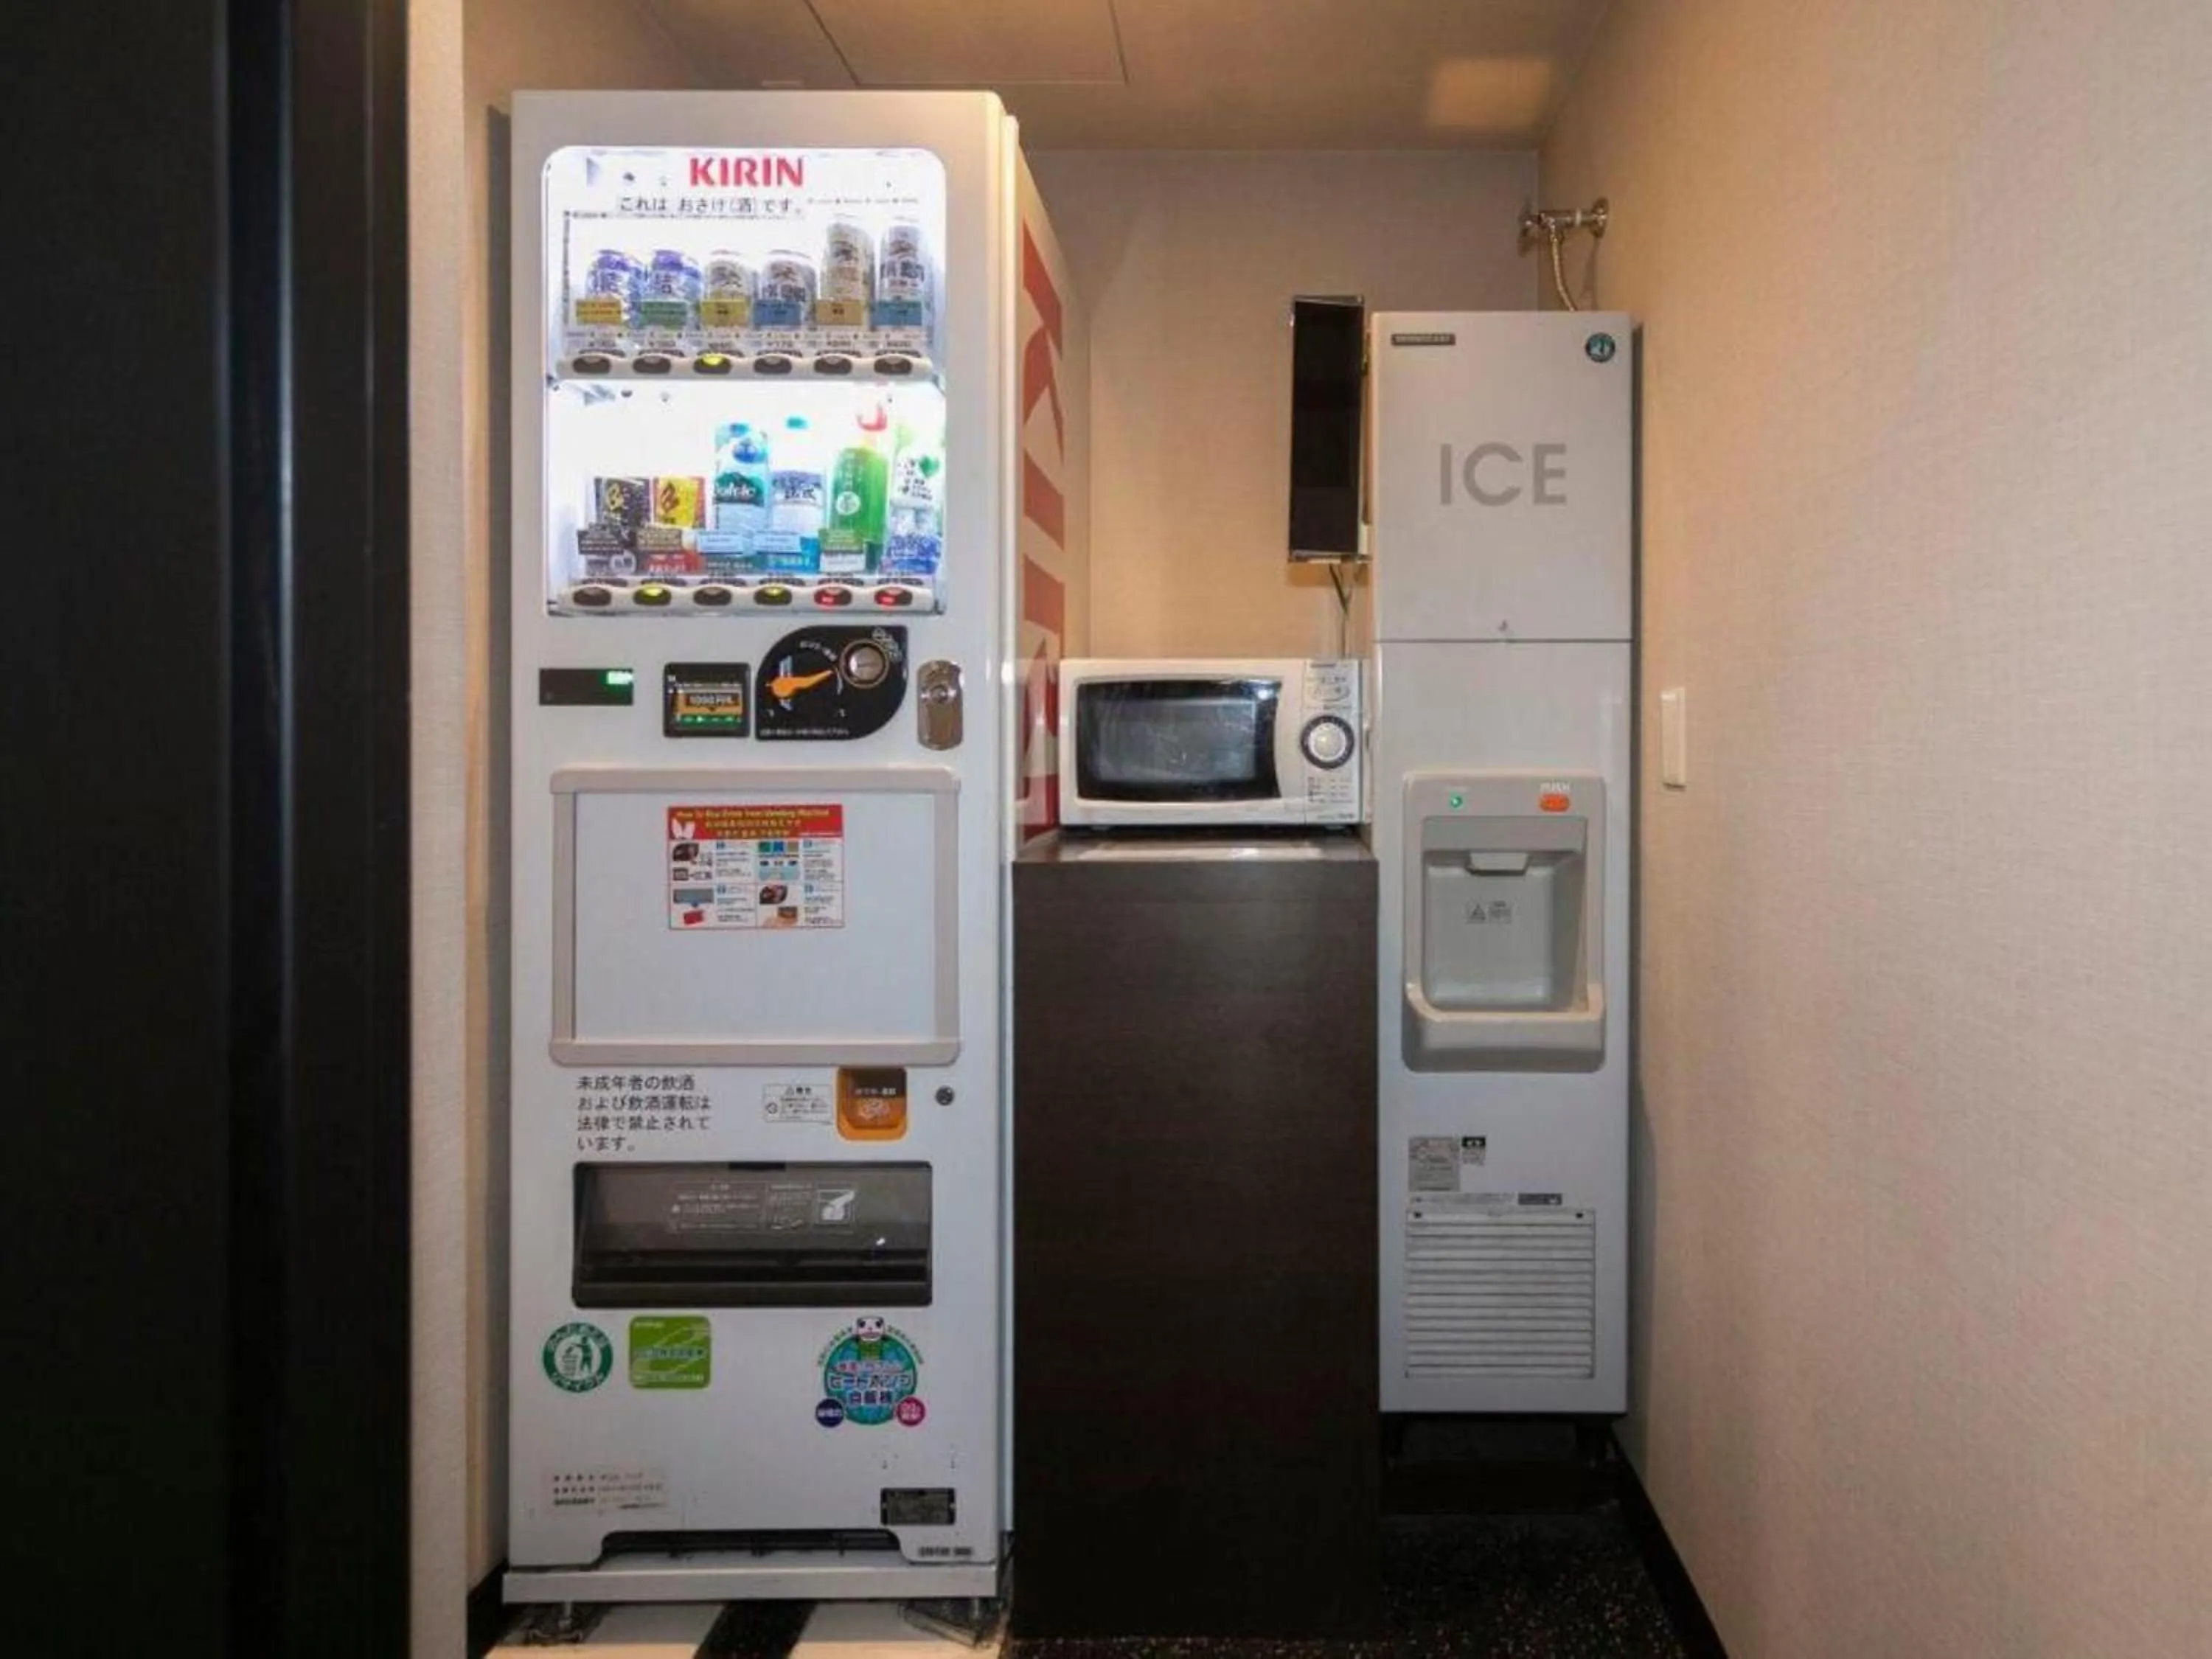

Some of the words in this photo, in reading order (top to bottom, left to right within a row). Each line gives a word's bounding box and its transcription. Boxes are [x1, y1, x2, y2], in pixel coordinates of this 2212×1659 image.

[689, 157, 804, 187] KIRIN
[620, 197, 667, 212] これは
[1440, 443, 1568, 507] ICE
[577, 1075, 695, 1091] 未成年者の飲酒
[578, 1095, 712, 1110] および飲酒運転は
[577, 1116, 712, 1131] 法律で禁止されて
[577, 1136, 636, 1152] います。
